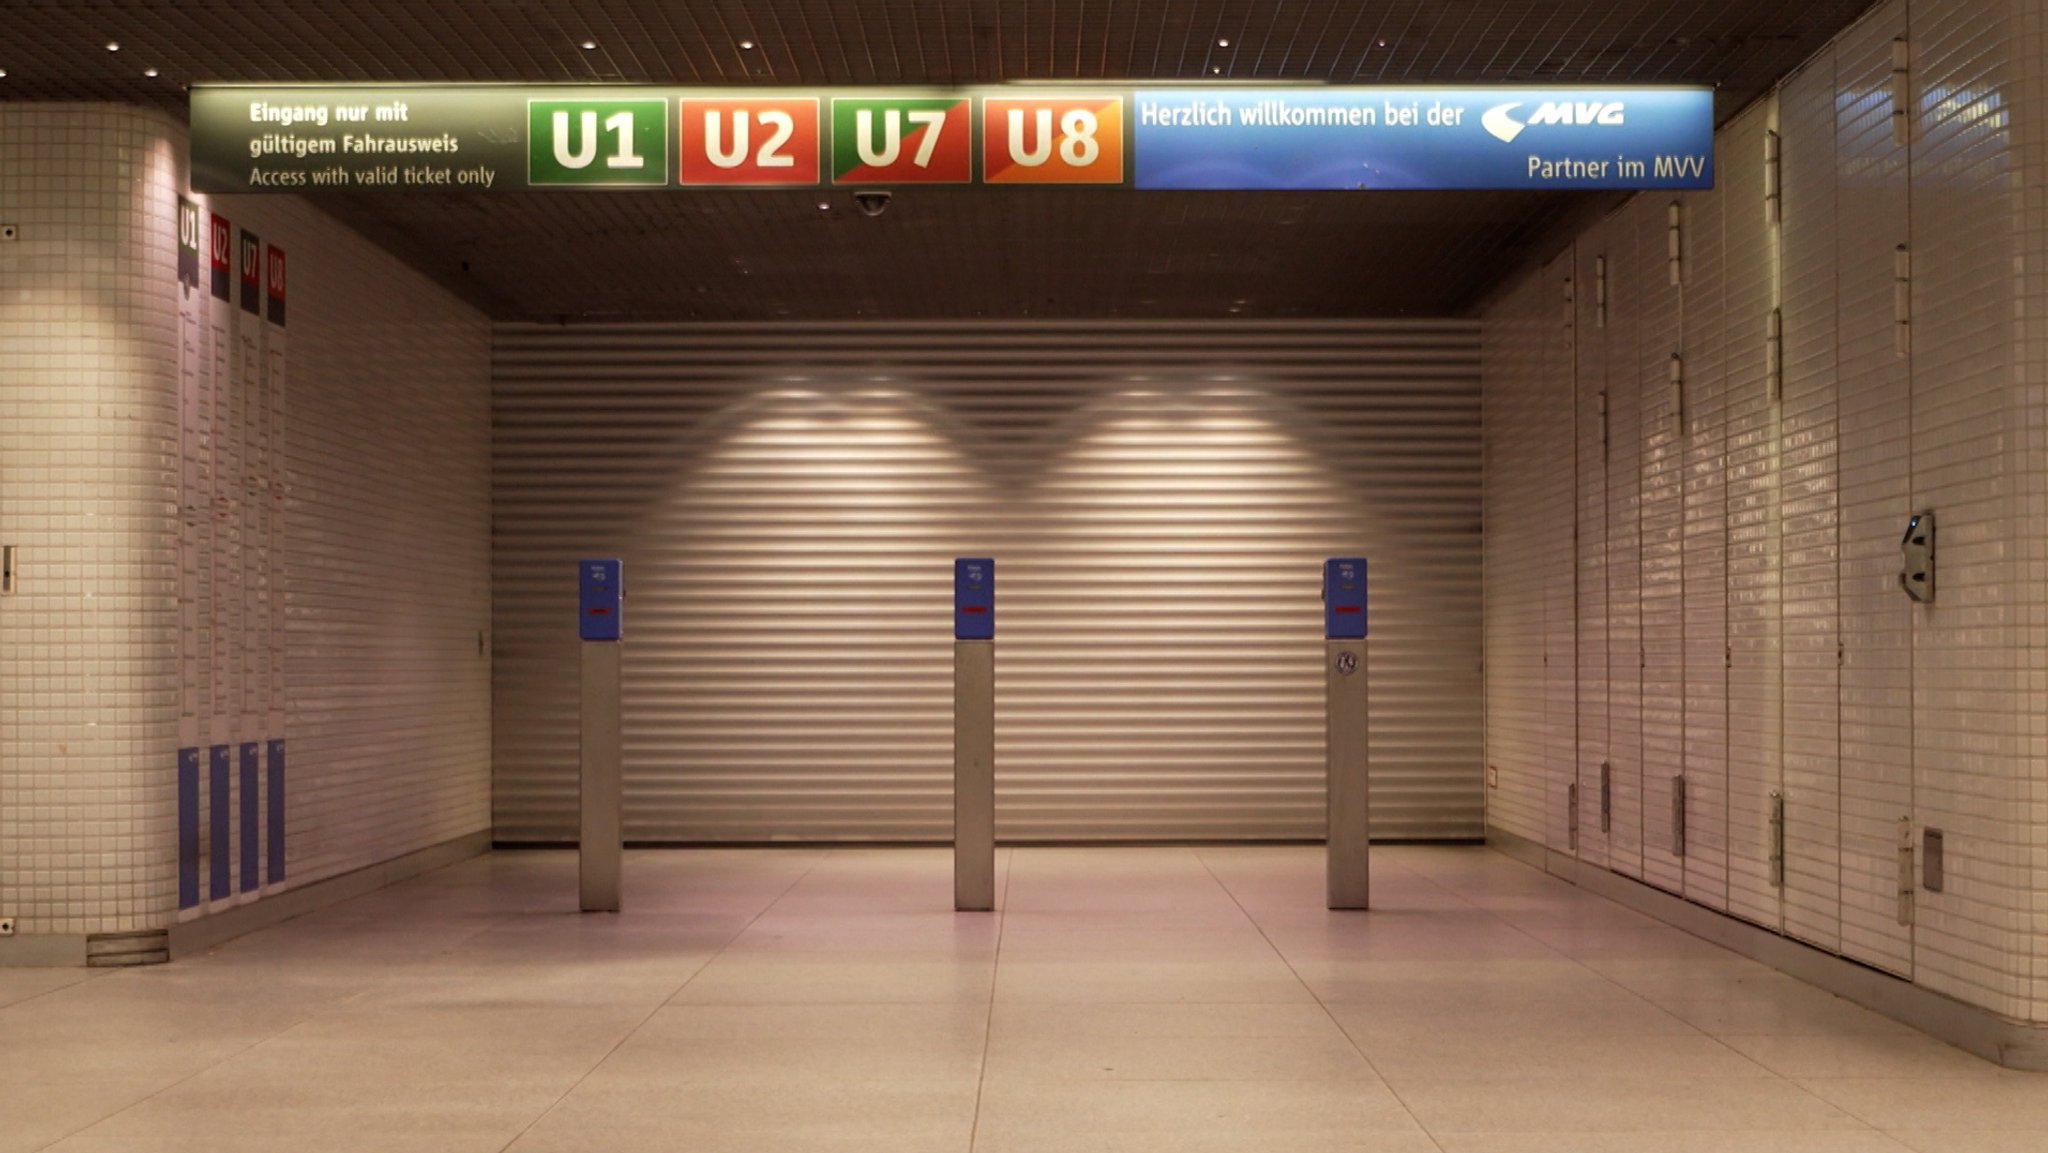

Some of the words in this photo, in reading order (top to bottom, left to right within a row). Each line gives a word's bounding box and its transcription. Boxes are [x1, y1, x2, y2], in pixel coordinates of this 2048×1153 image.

[250, 102, 328, 126] Eingang
[336, 106, 369, 122] nur
[375, 101, 409, 122] mit
[1141, 101, 1231, 126] Herzlich
[1239, 101, 1375, 126] willkommen
[1385, 101, 1419, 126] bei
[1426, 101, 1465, 126] der
[1527, 102, 1624, 125] MVG
[250, 133, 336, 158] gültigem
[343, 134, 459, 153] Fahrausweis
[552, 111, 644, 169] U1
[705, 111, 795, 169] U2
[856, 110, 947, 169] U7
[1007, 109, 1099, 168] U8
[250, 167, 306, 185] Access
[312, 166, 349, 185] with
[356, 166, 397, 185] valid
[404, 166, 451, 185] ticket
[457, 166, 495, 188] only
[1528, 156, 1609, 179] Partner
[1618, 155, 1645, 179] im
[1653, 157, 1705, 179] MVV
[181, 205, 197, 250] U1
[213, 221, 228, 265] U2
[243, 239, 257, 278] U7
[270, 253, 283, 292] U8
